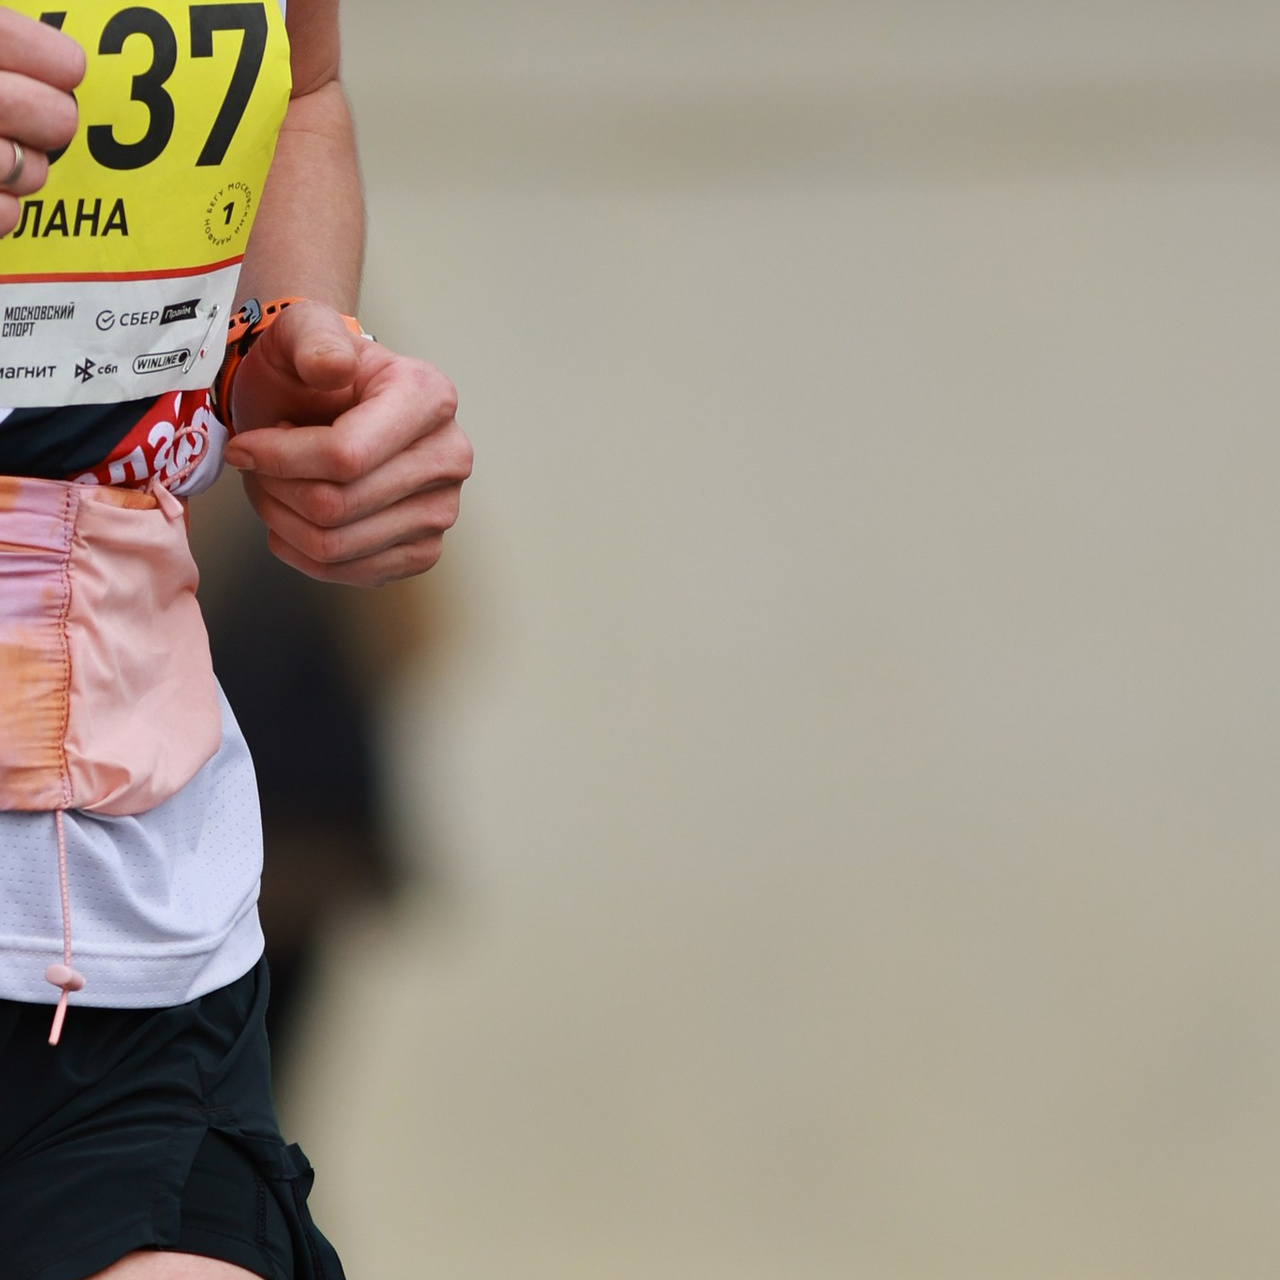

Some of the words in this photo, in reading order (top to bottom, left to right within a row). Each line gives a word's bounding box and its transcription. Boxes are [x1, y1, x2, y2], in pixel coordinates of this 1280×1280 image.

[223, 201, 235, 226] 1
[3, 301, 75, 321] МОСКОВСКИЙ
[120, 310, 160, 327] СБЕР
[1, 322, 36, 338] СПОРТ
[137, 354, 179, 371] WINLINE
